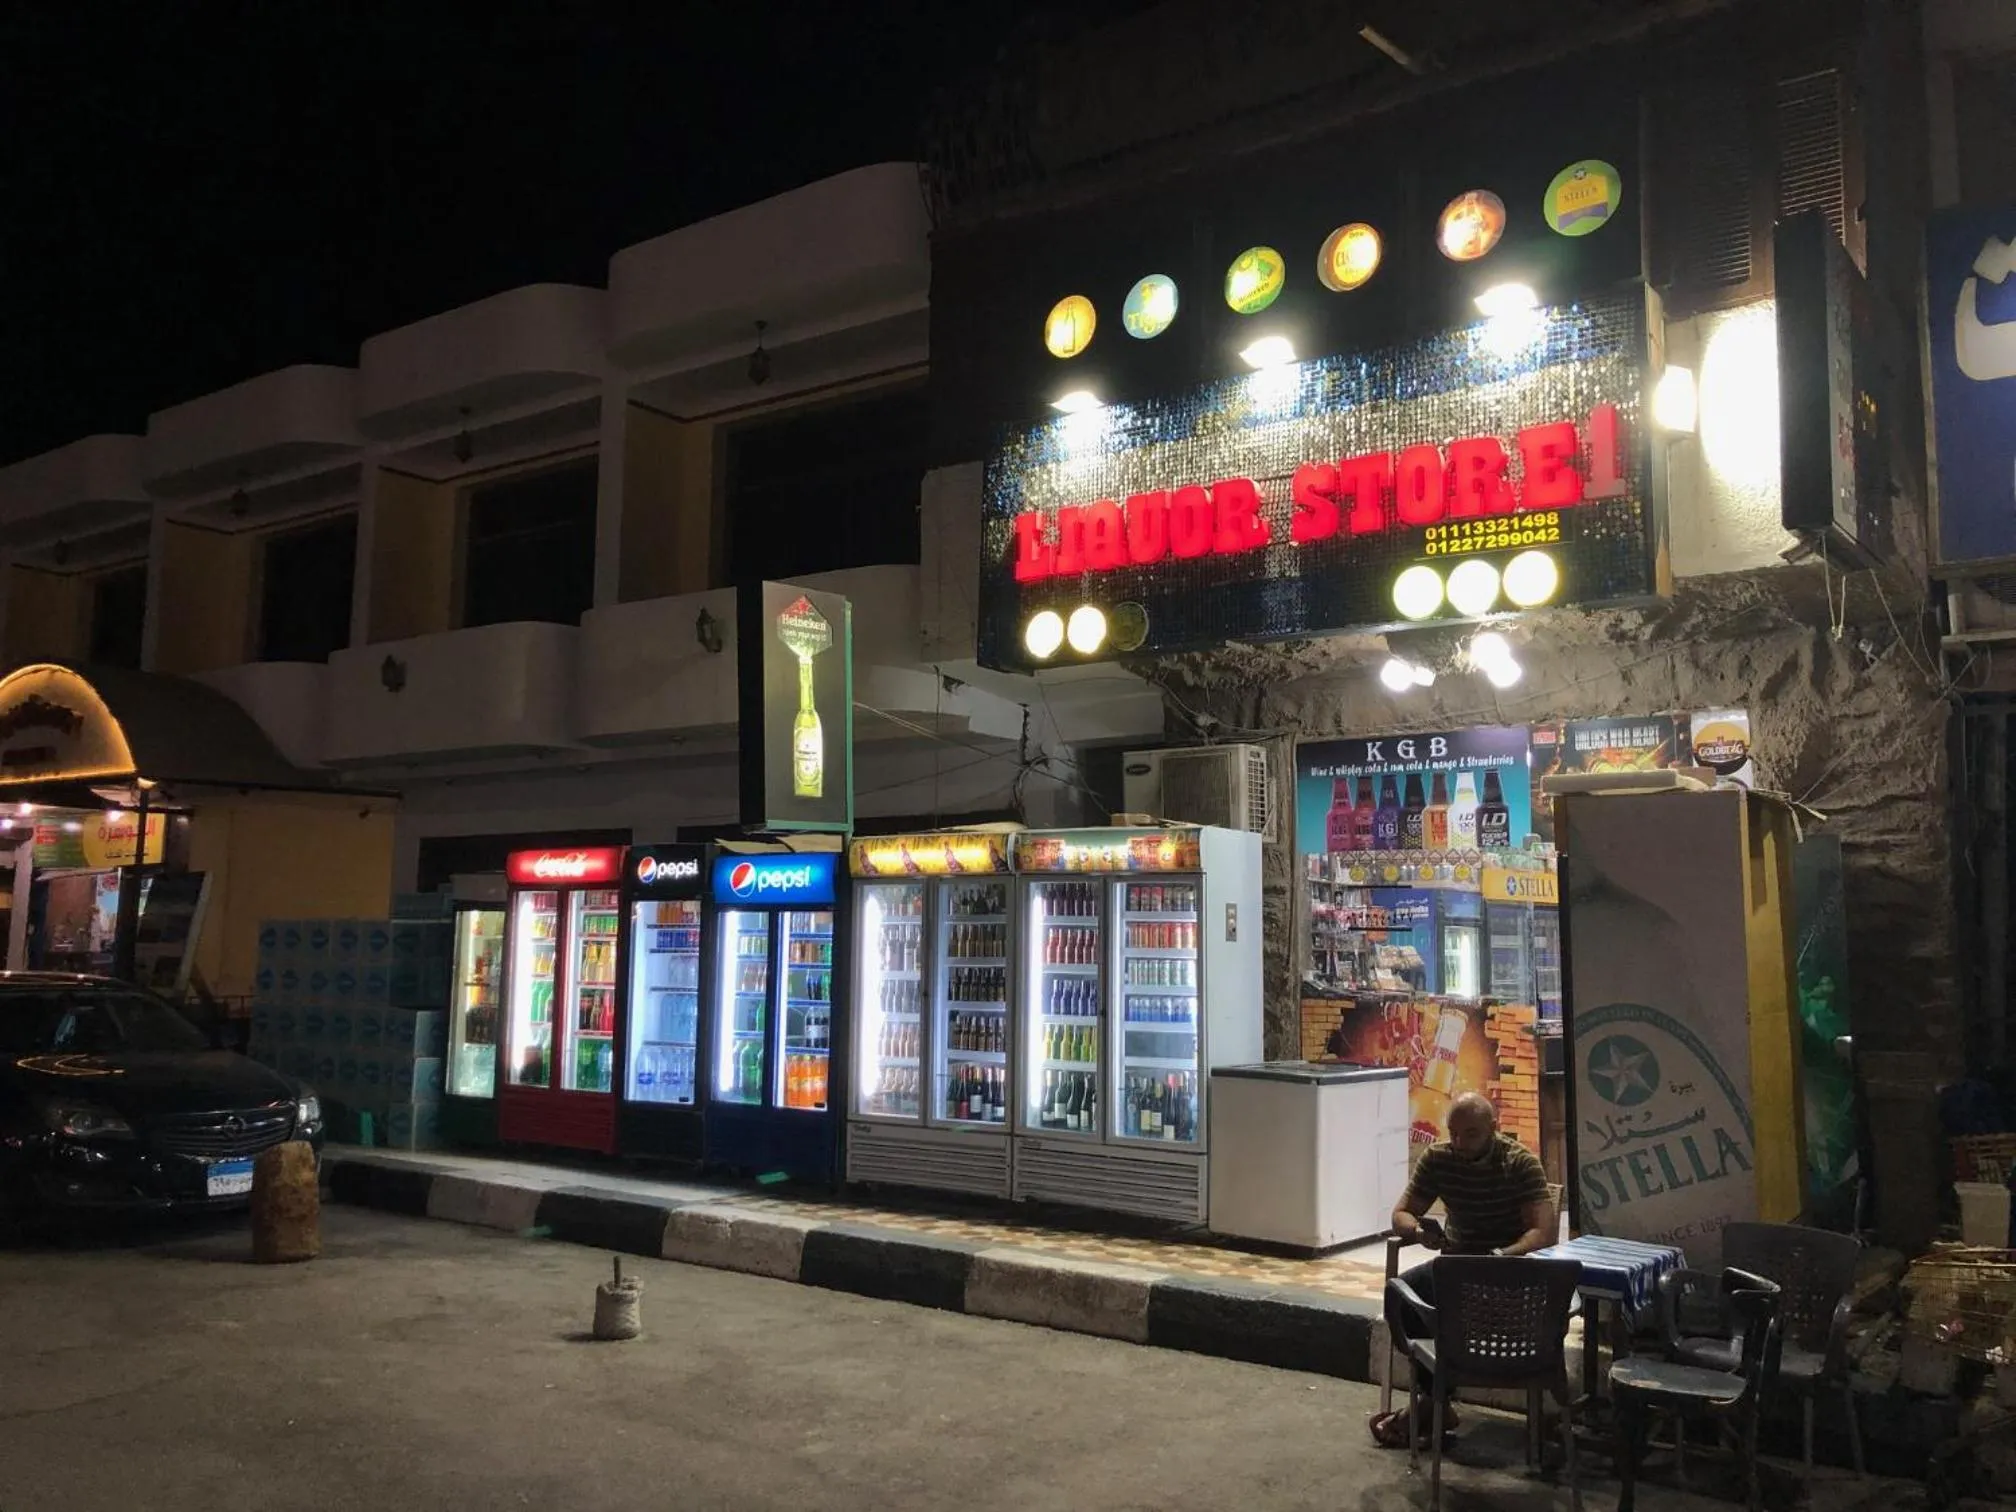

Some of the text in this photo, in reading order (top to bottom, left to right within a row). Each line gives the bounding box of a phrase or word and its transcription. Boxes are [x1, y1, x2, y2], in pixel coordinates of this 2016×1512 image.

[1425, 511, 1559, 541] 01113321498
[1425, 527, 1560, 555] 01227299042
[782, 613, 826, 631] Heineken
[657, 858, 698, 879] pepsi
[758, 866, 811, 892] pepsi
[1517, 876, 1555, 897] STELLA
[1580, 1127, 1752, 1211] STELLA
